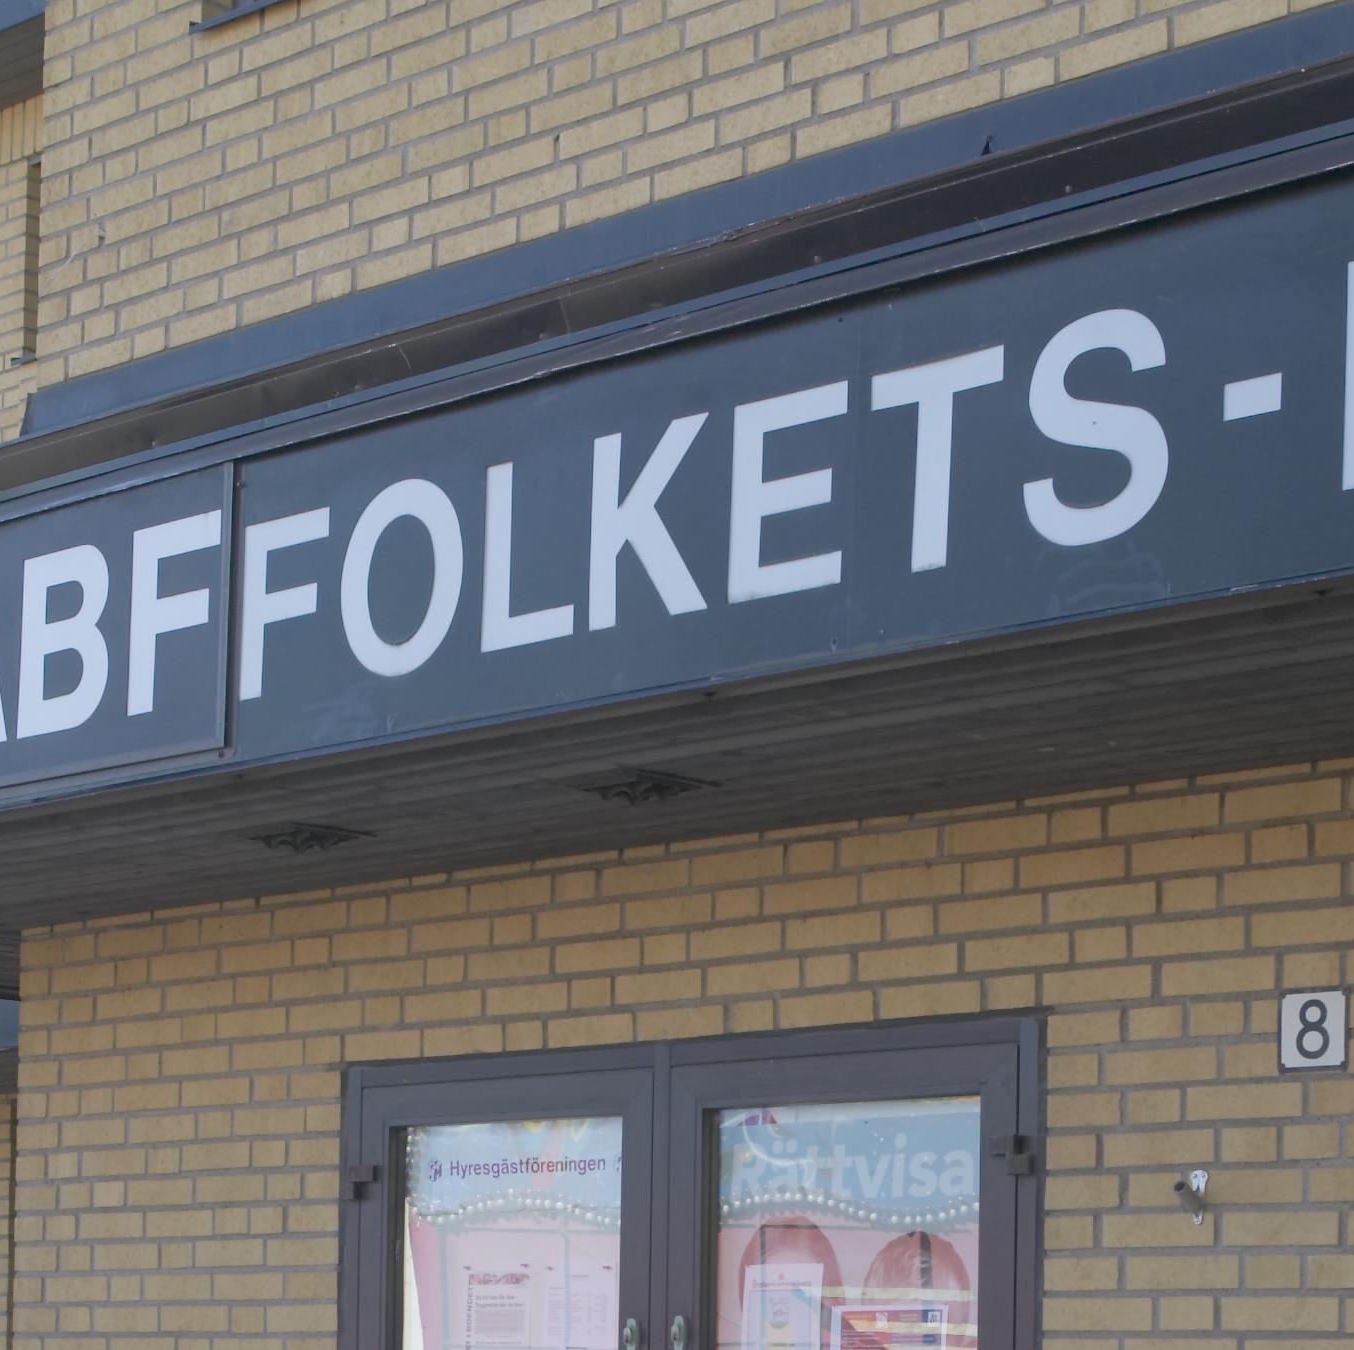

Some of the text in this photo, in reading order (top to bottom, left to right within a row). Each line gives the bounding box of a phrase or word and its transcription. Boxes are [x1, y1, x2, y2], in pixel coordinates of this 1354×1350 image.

[1296, 999, 1329, 1059] 8
[450, 1156, 606, 1180] Hyresgästföreningen
[730, 1133, 975, 1200] Rättvisa
